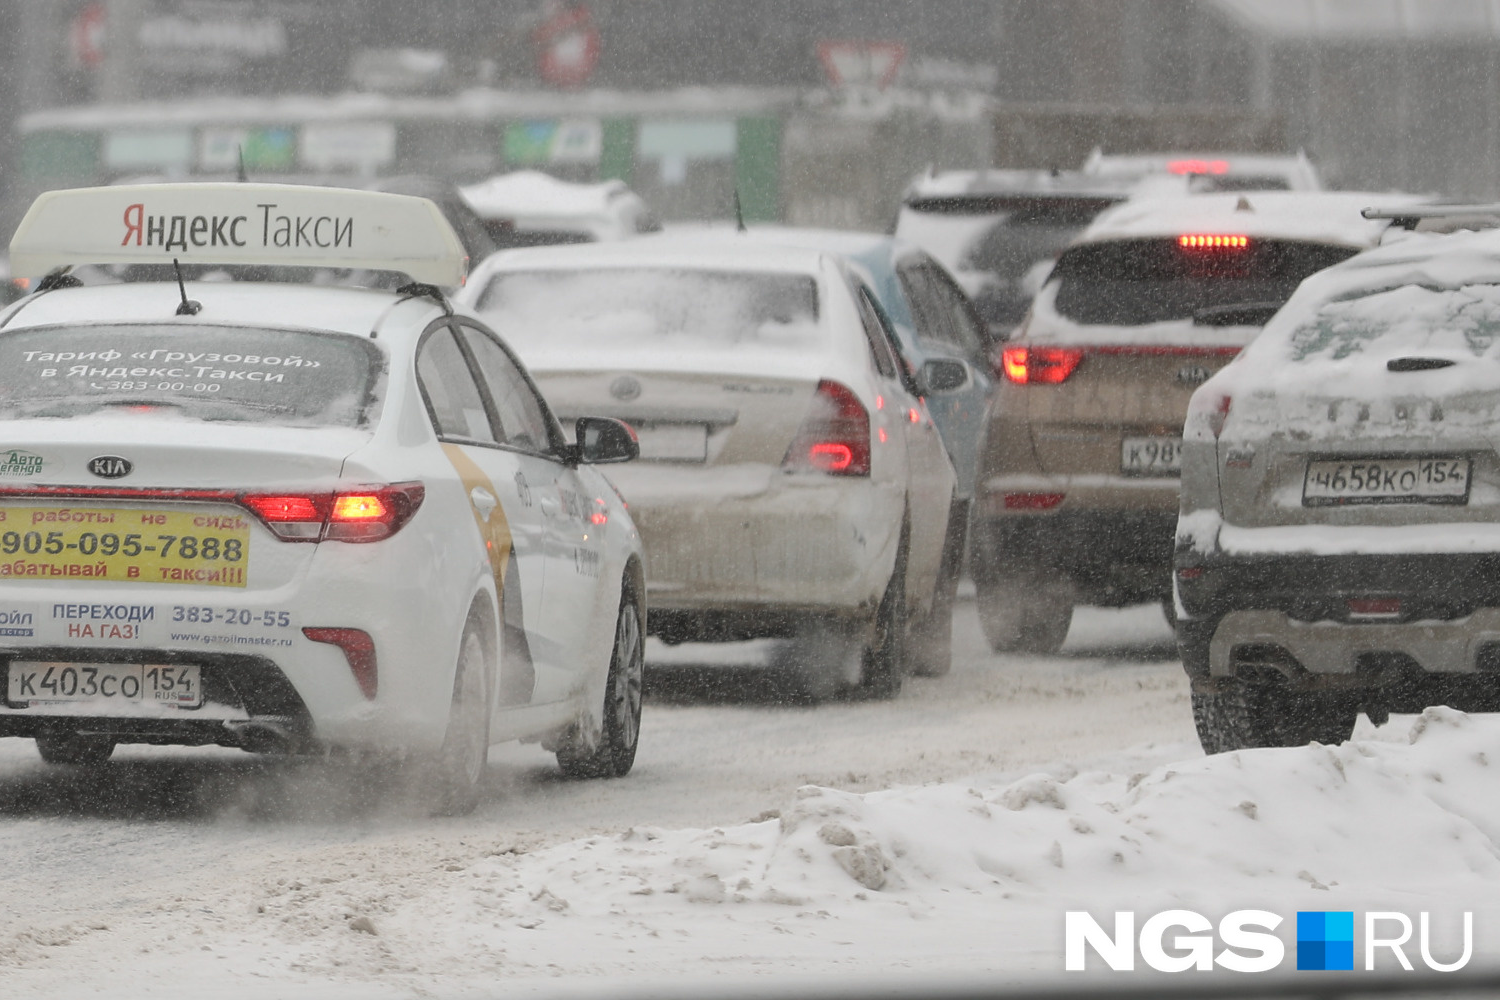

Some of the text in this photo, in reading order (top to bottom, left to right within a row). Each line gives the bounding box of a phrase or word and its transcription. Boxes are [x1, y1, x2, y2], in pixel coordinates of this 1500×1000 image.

[121, 203, 354, 251] Яндекс Такси
[22, 349, 321, 368] Тариф «Грузовой»
[40, 364, 285, 383] в Яндекс.Такси
[106, 381, 221, 393] 383-00-00
[8, 452, 43, 465] Авто
[94, 460, 126, 475] KIA
[1422, 461, 1460, 484] 154
[33, 508, 115, 525] работы
[141, 513, 167, 525] не
[127, 567, 140, 578] в
[159, 566, 242, 584] такси!!!
[53, 604, 155, 622] ПЕРЕХОДИ
[172, 606, 290, 627] 383-20-55
[68, 624, 139, 639] НА ГАЗ!
[171, 633, 292, 646] www.gazoilmaster.ru
[146, 667, 191, 691] 154
[155, 691, 178, 700] RUS
